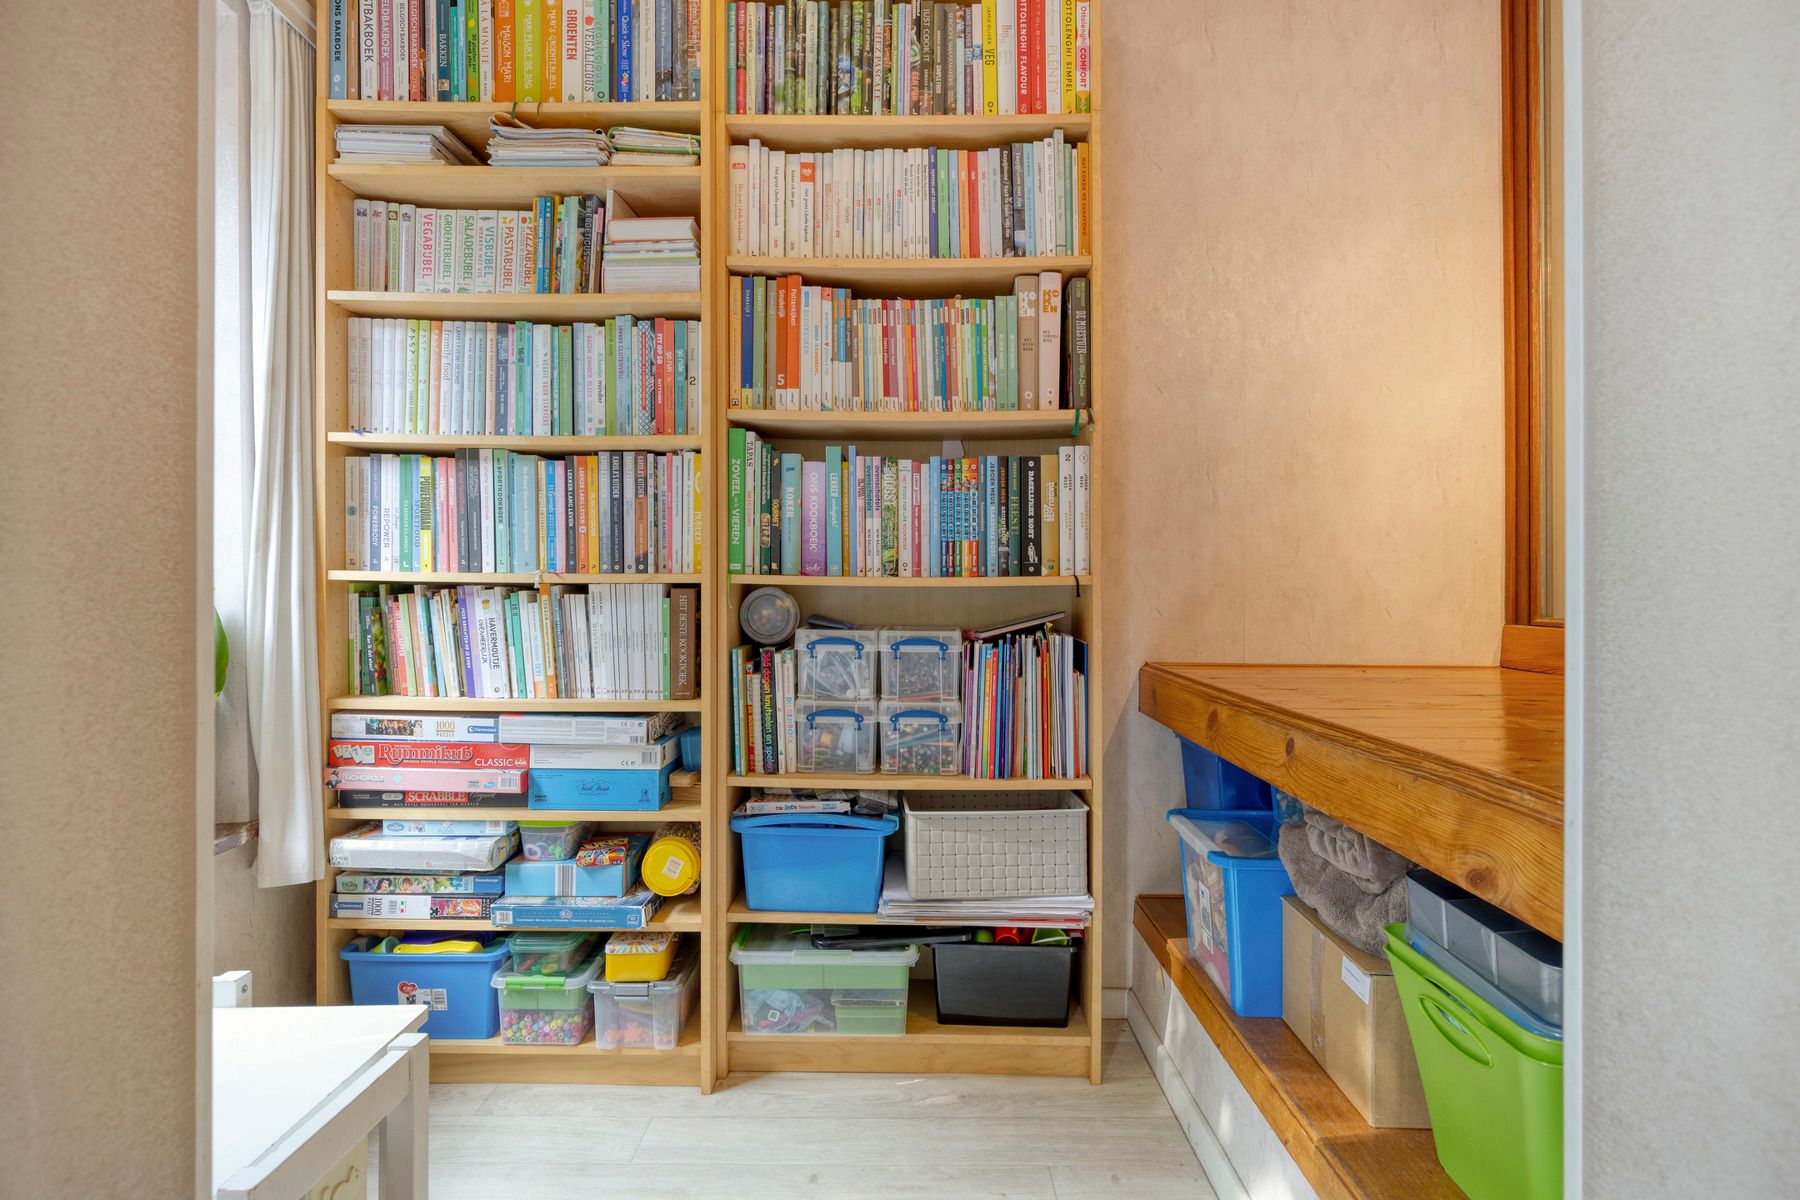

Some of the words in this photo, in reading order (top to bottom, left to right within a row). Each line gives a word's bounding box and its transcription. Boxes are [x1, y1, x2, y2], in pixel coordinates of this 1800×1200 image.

[481, 10, 489, 22] LA
[621, 15, 629, 35] Quick
[922, 9, 931, 27] JUST
[1079, 5, 1089, 45] Ottolenghi
[333, 20, 342, 62] BAKBOEK
[481, 27, 489, 65] MINUTE
[499, 25, 512, 58] MAISON
[566, 9, 578, 60] GROENTEN
[873, 24, 882, 53] CHEZ
[922, 29, 931, 53] COOK
[411, 34, 419, 69] BAKBOEK
[439, 33, 448, 68] BAKKEN
[584, 28, 595, 93] VEGALICIOUS
[595, 20, 604, 84] VEGALICIOUS
[621, 40, 631, 57] Slow
[985, 48, 996, 66] VEG
[500, 61, 512, 83] MARI
[874, 56, 882, 101] PASCALE
[1047, 44, 1059, 96] PLENTY
[1079, 47, 1087, 88] COMFORT
[1075, 310, 1087, 319] DE
[1075, 320, 1087, 354] MOESTUIN
[657, 355, 663, 364] 50
[666, 351, 673, 361] go
[442, 362, 452, 381] food
[542, 359, 550, 379] VEGGIE
[689, 376, 697, 386] 2
[779, 373, 785, 386] 5
[746, 441, 754, 467] TAPAS
[1065, 453, 1072, 462] 2
[732, 458, 740, 497] ZOVEEL
[810, 472, 818, 493] ONS
[830, 473, 839, 497] LEKKER
[420, 476, 431, 531] POWERWOMAN
[496, 466, 504, 525] SPORTKOOKBOEK
[786, 487, 794, 518] KOKEN
[383, 508, 391, 548] REPOWER
[732, 508, 740, 544] VIEREN
[810, 495, 818, 551] KOOKBOEK
[1010, 496, 1019, 535] FEEST!
[679, 595, 688, 611] HET
[679, 613, 688, 637] BESTE
[478, 618, 488, 665] OVENHEERLIJK
[488, 617, 501, 670] HAVERMOUTJE
[678, 638, 688, 687] KOOKBOEK
[763, 652, 771, 667] 365
[762, 668, 772, 694] dagen
[436, 721, 455, 730] 1000
[764, 695, 773, 733] knutselen
[766, 734, 771, 745] en
[378, 743, 474, 765] Rummikub
[474, 758, 513, 767] CLASSIC
[764, 746, 775, 771] spelen
[344, 773, 385, 783] MONOPOLY
[407, 791, 466, 802] SCRABBLE
[375, 897, 383, 917] 1000
